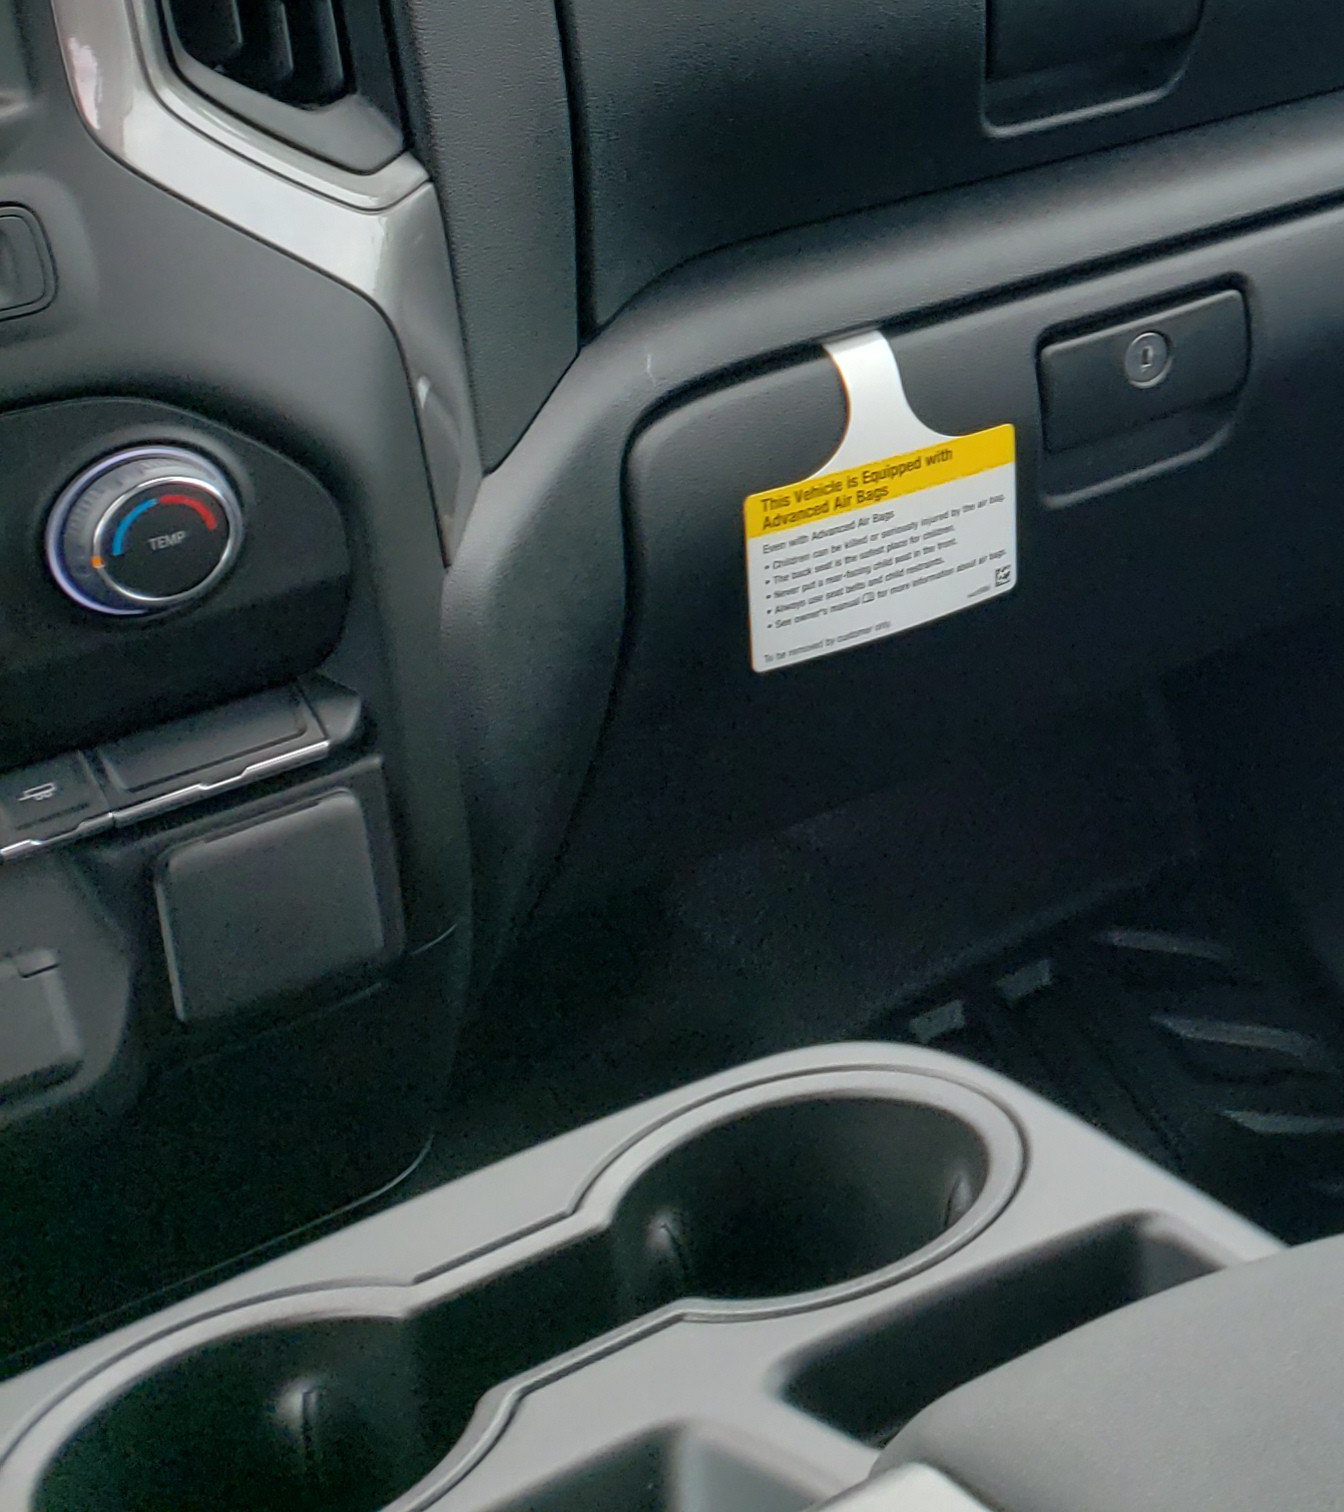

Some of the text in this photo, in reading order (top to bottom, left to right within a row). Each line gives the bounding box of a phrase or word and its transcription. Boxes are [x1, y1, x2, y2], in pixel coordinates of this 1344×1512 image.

[760, 448, 953, 512] This Vehicle is Equipped with
[762, 485, 889, 530] Advanced Air Bags
[147, 530, 186, 551] TEMP
[762, 510, 895, 554] Even with Advanced Air Bags
[772, 553, 810, 570] Children
[812, 548, 829, 558] can
[831, 544, 842, 553] be
[844, 535, 868, 549] killed
[773, 574, 790, 584] The
[791, 568, 812, 579] back
